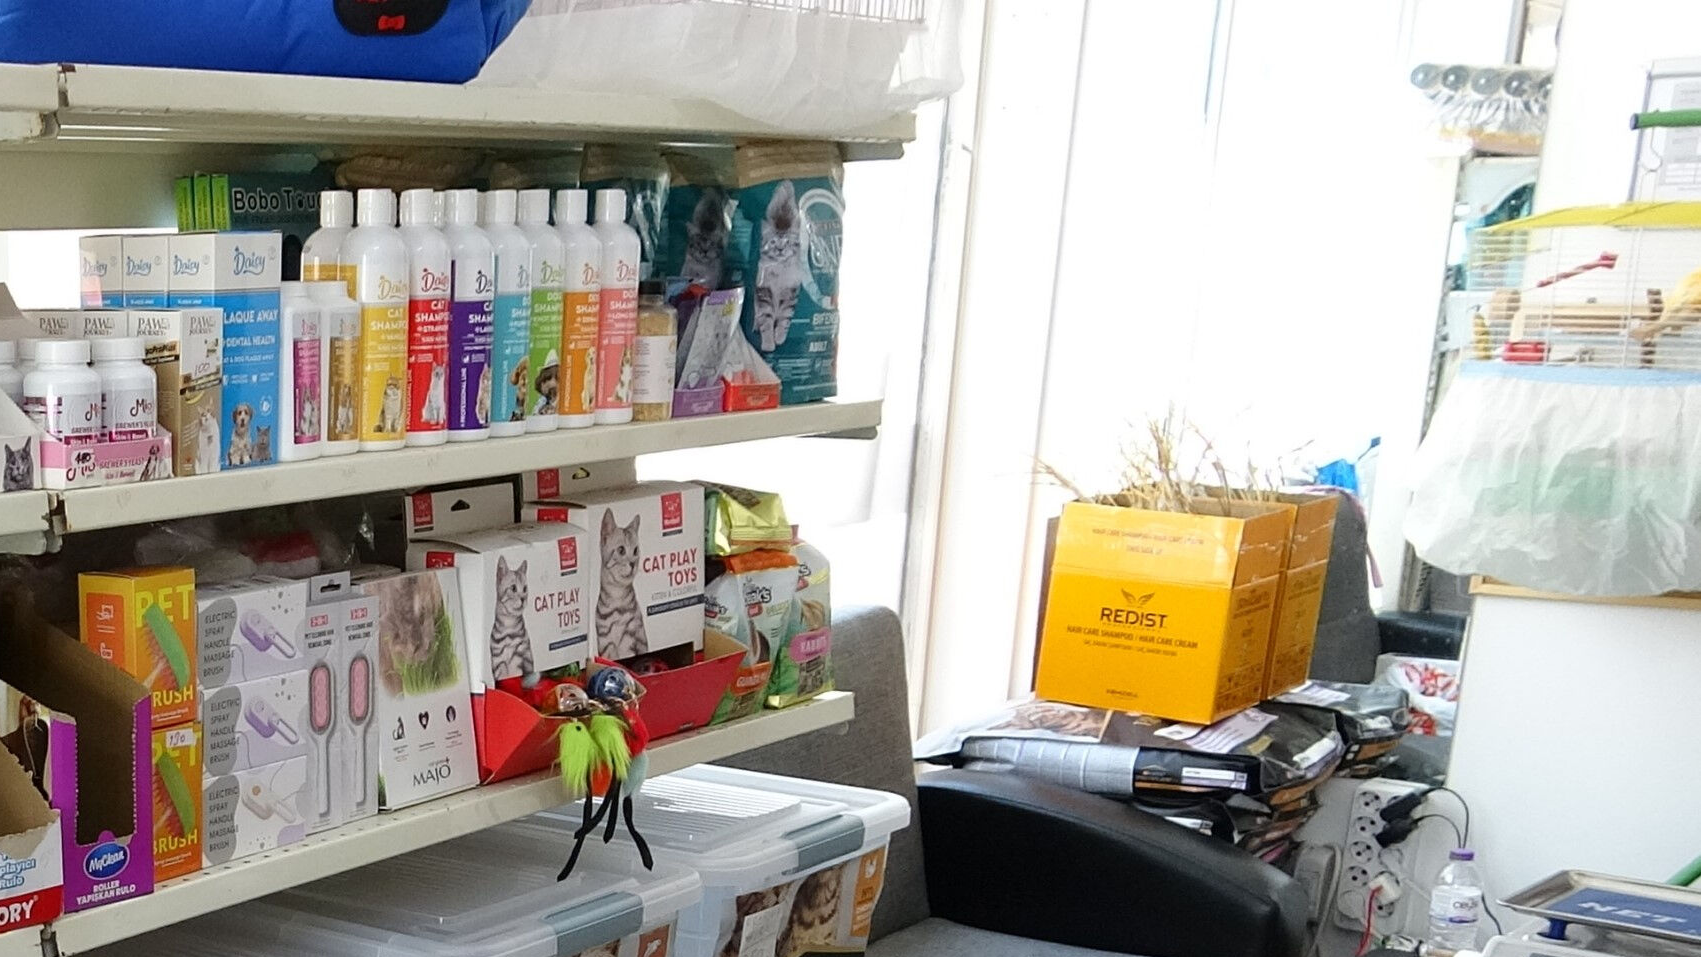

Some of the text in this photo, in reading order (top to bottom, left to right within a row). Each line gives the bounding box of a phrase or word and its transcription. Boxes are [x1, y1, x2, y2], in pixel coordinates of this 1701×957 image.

[232, 189, 280, 213] Bobo
[233, 246, 266, 277] Daisy
[256, 308, 279, 322] AWAY
[642, 547, 698, 574] CAT PLAY
[667, 566, 698, 588] TOYS
[135, 583, 195, 629] PET
[534, 586, 581, 613] CAT PLAY
[557, 608, 581, 629] TOYS
[1099, 607, 1168, 630] REDIST
[412, 764, 451, 787] MAJO
[92, 879, 121, 894] ROLLER
[116, 884, 137, 898] RULO
[1578, 901, 1688, 925] NET
